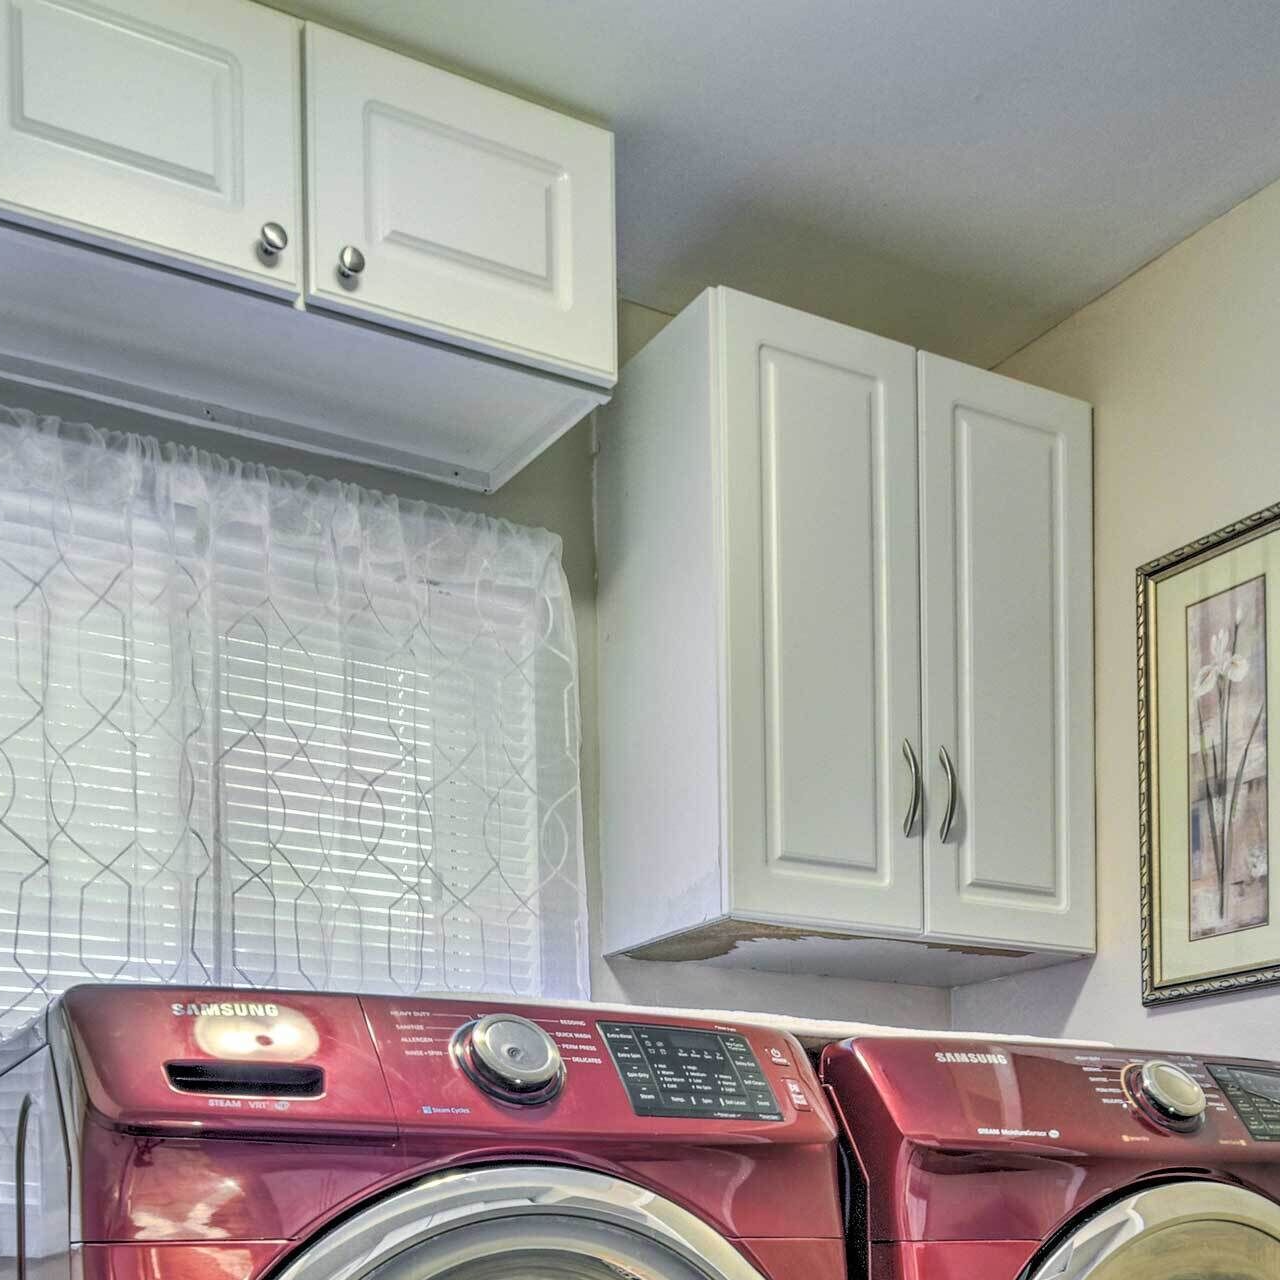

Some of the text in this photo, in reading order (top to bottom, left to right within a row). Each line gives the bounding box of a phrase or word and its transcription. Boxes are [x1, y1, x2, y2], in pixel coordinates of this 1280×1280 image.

[172, 1003, 279, 1017] SAMSUNG
[934, 1052, 1008, 1064] SAMSUNG
[208, 1099, 241, 1108] STEAM
